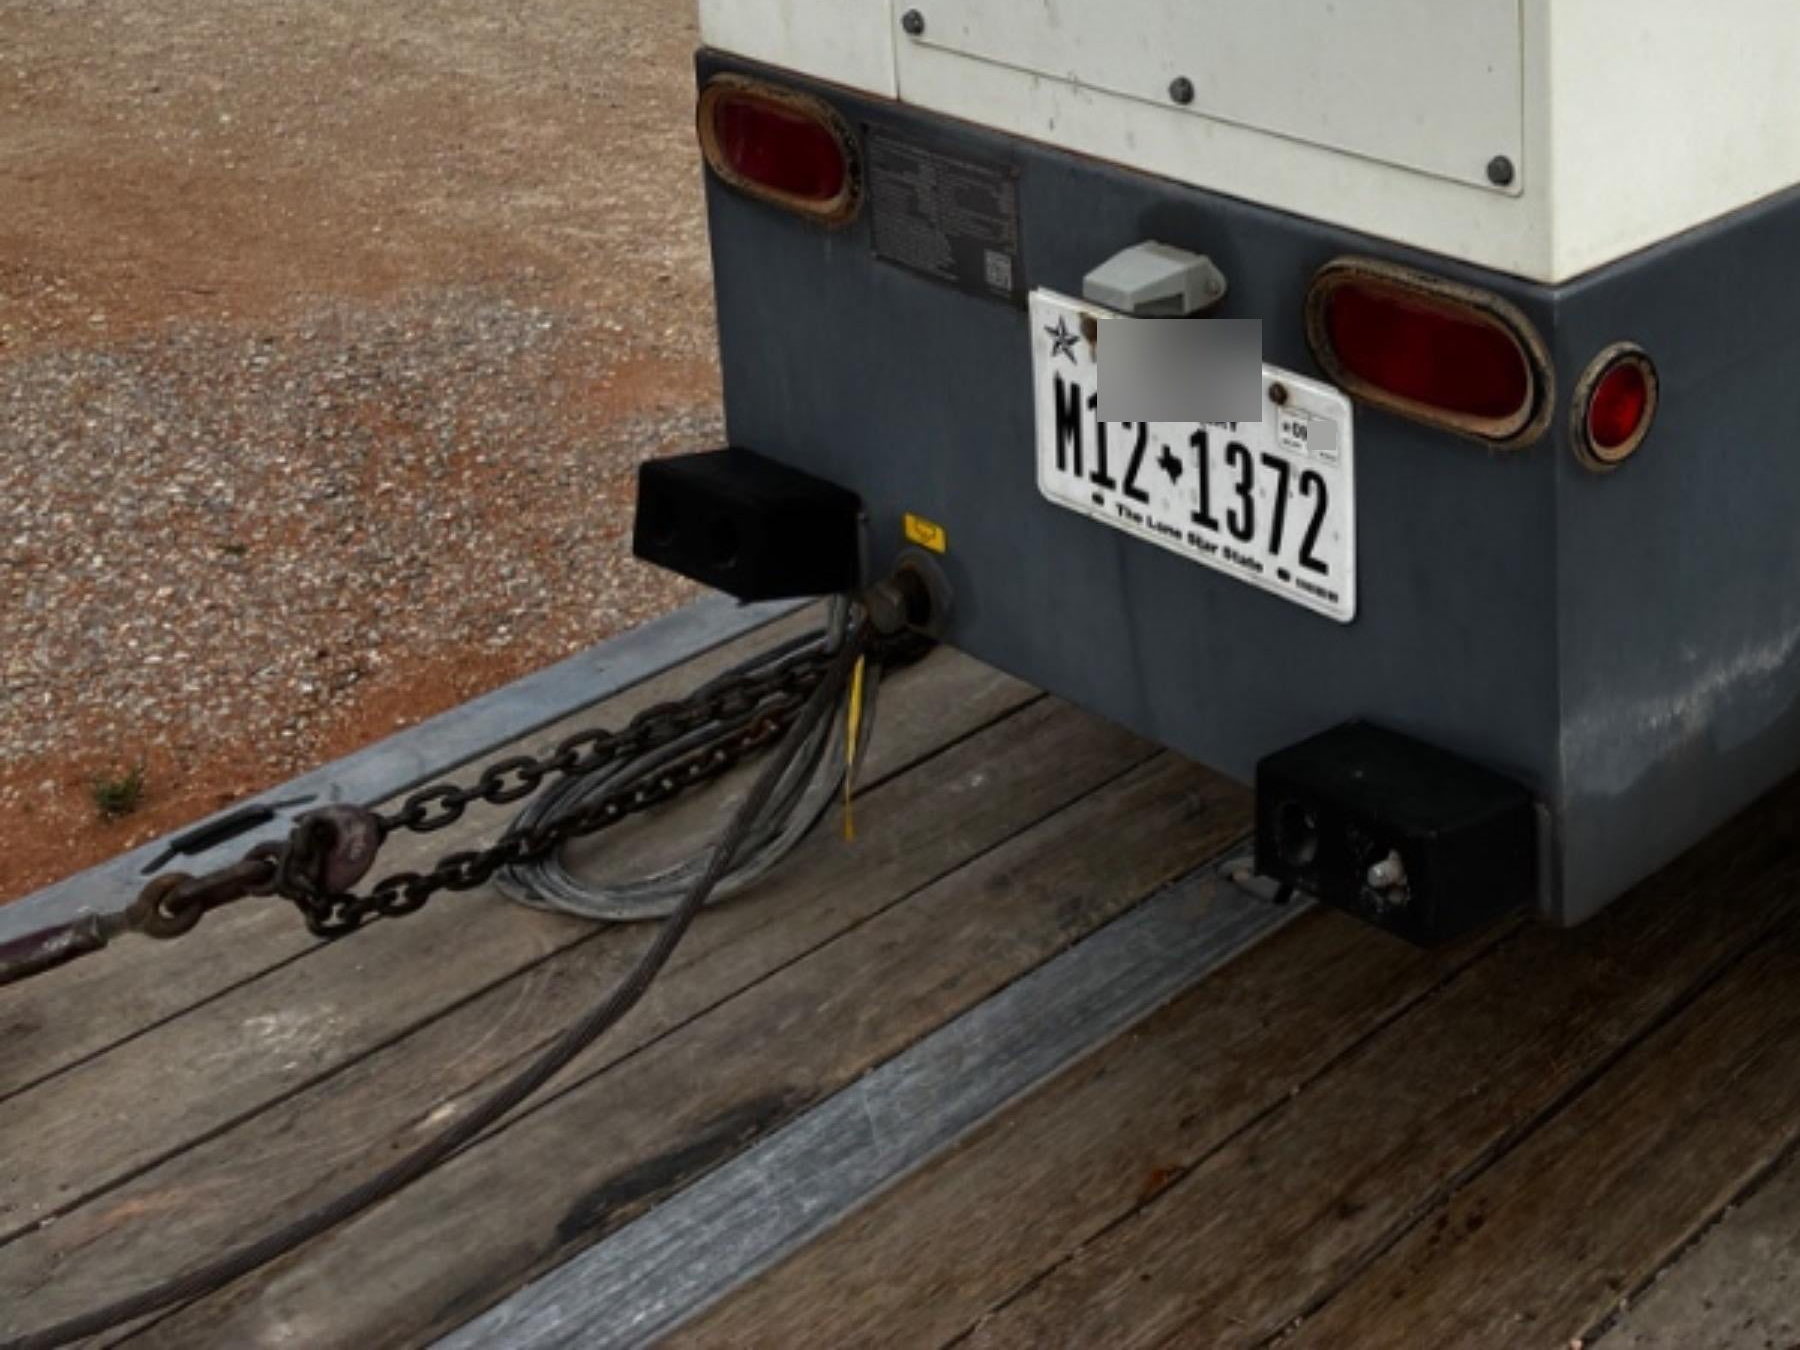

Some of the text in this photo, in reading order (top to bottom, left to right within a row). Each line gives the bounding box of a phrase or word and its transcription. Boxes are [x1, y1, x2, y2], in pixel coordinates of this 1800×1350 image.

[1116, 503, 1263, 572] The Lone Star State
